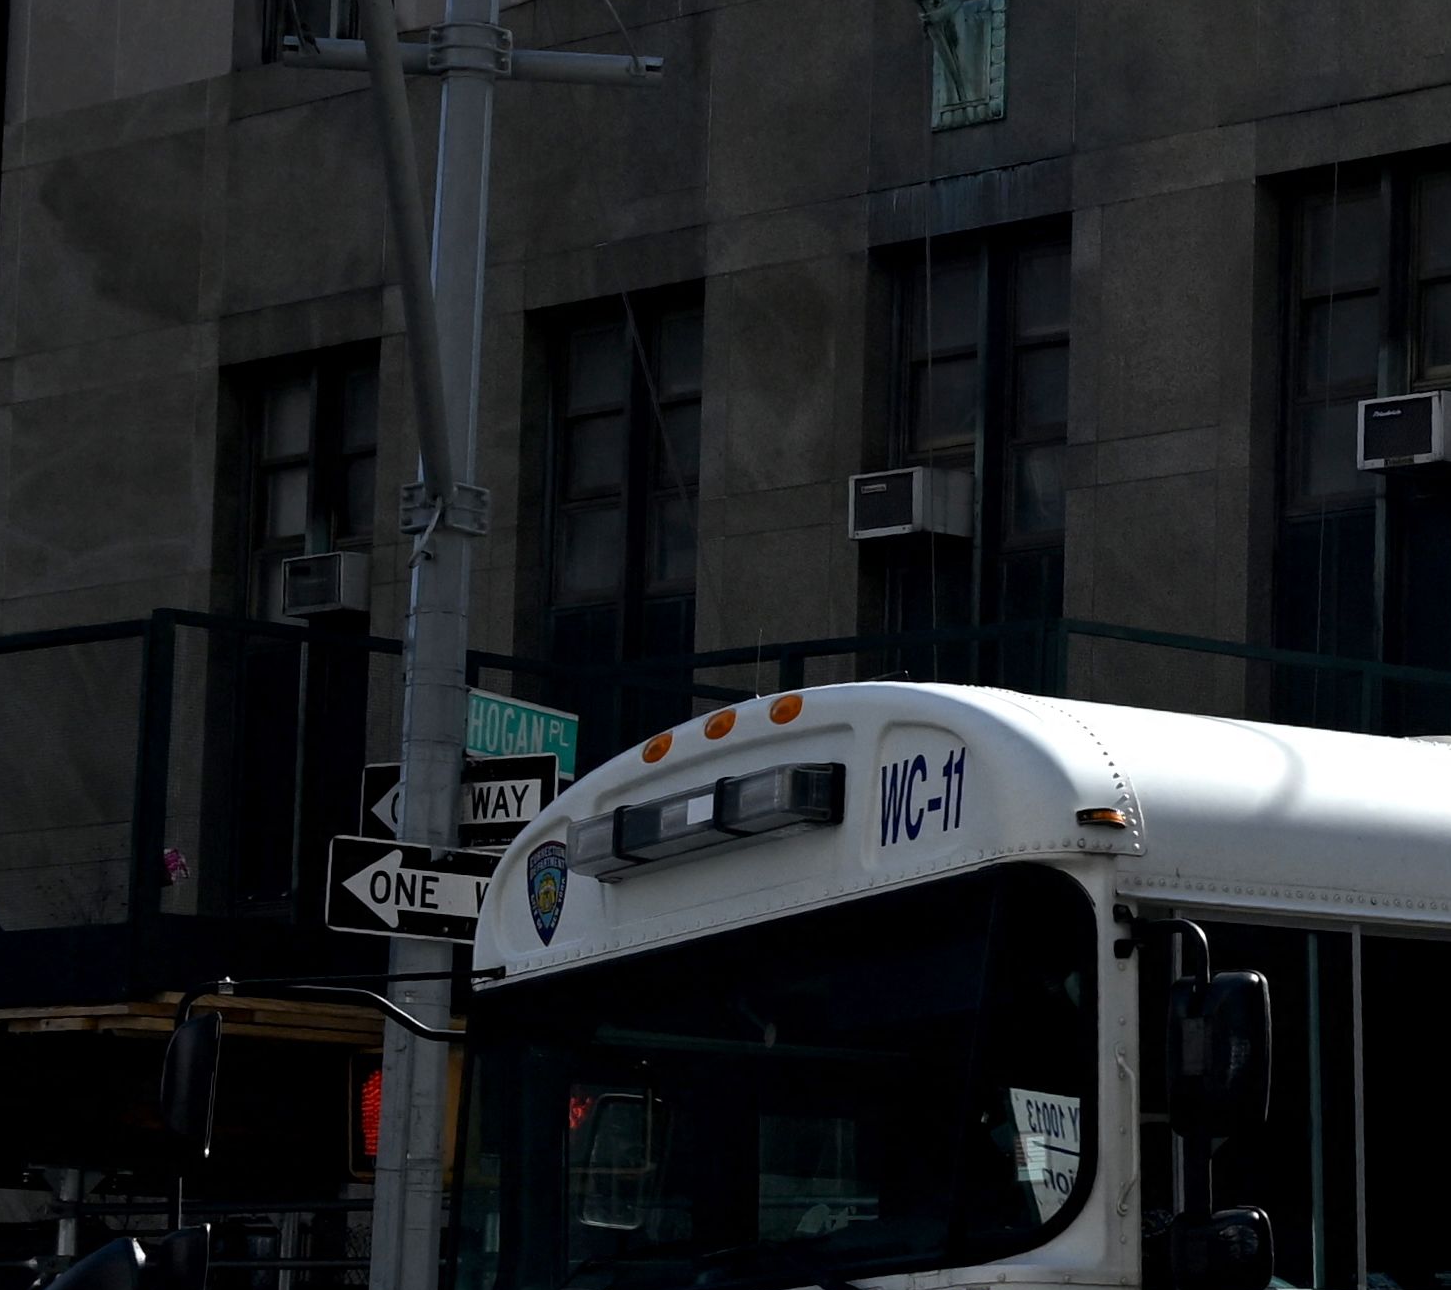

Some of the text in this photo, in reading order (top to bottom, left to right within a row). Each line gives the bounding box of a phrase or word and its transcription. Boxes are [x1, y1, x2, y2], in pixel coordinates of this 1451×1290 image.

[468, 699, 570, 756] HOGAN PL
[471, 784, 530, 820] WAY
[881, 747, 966, 846] WC-11
[369, 870, 440, 910] ONE
